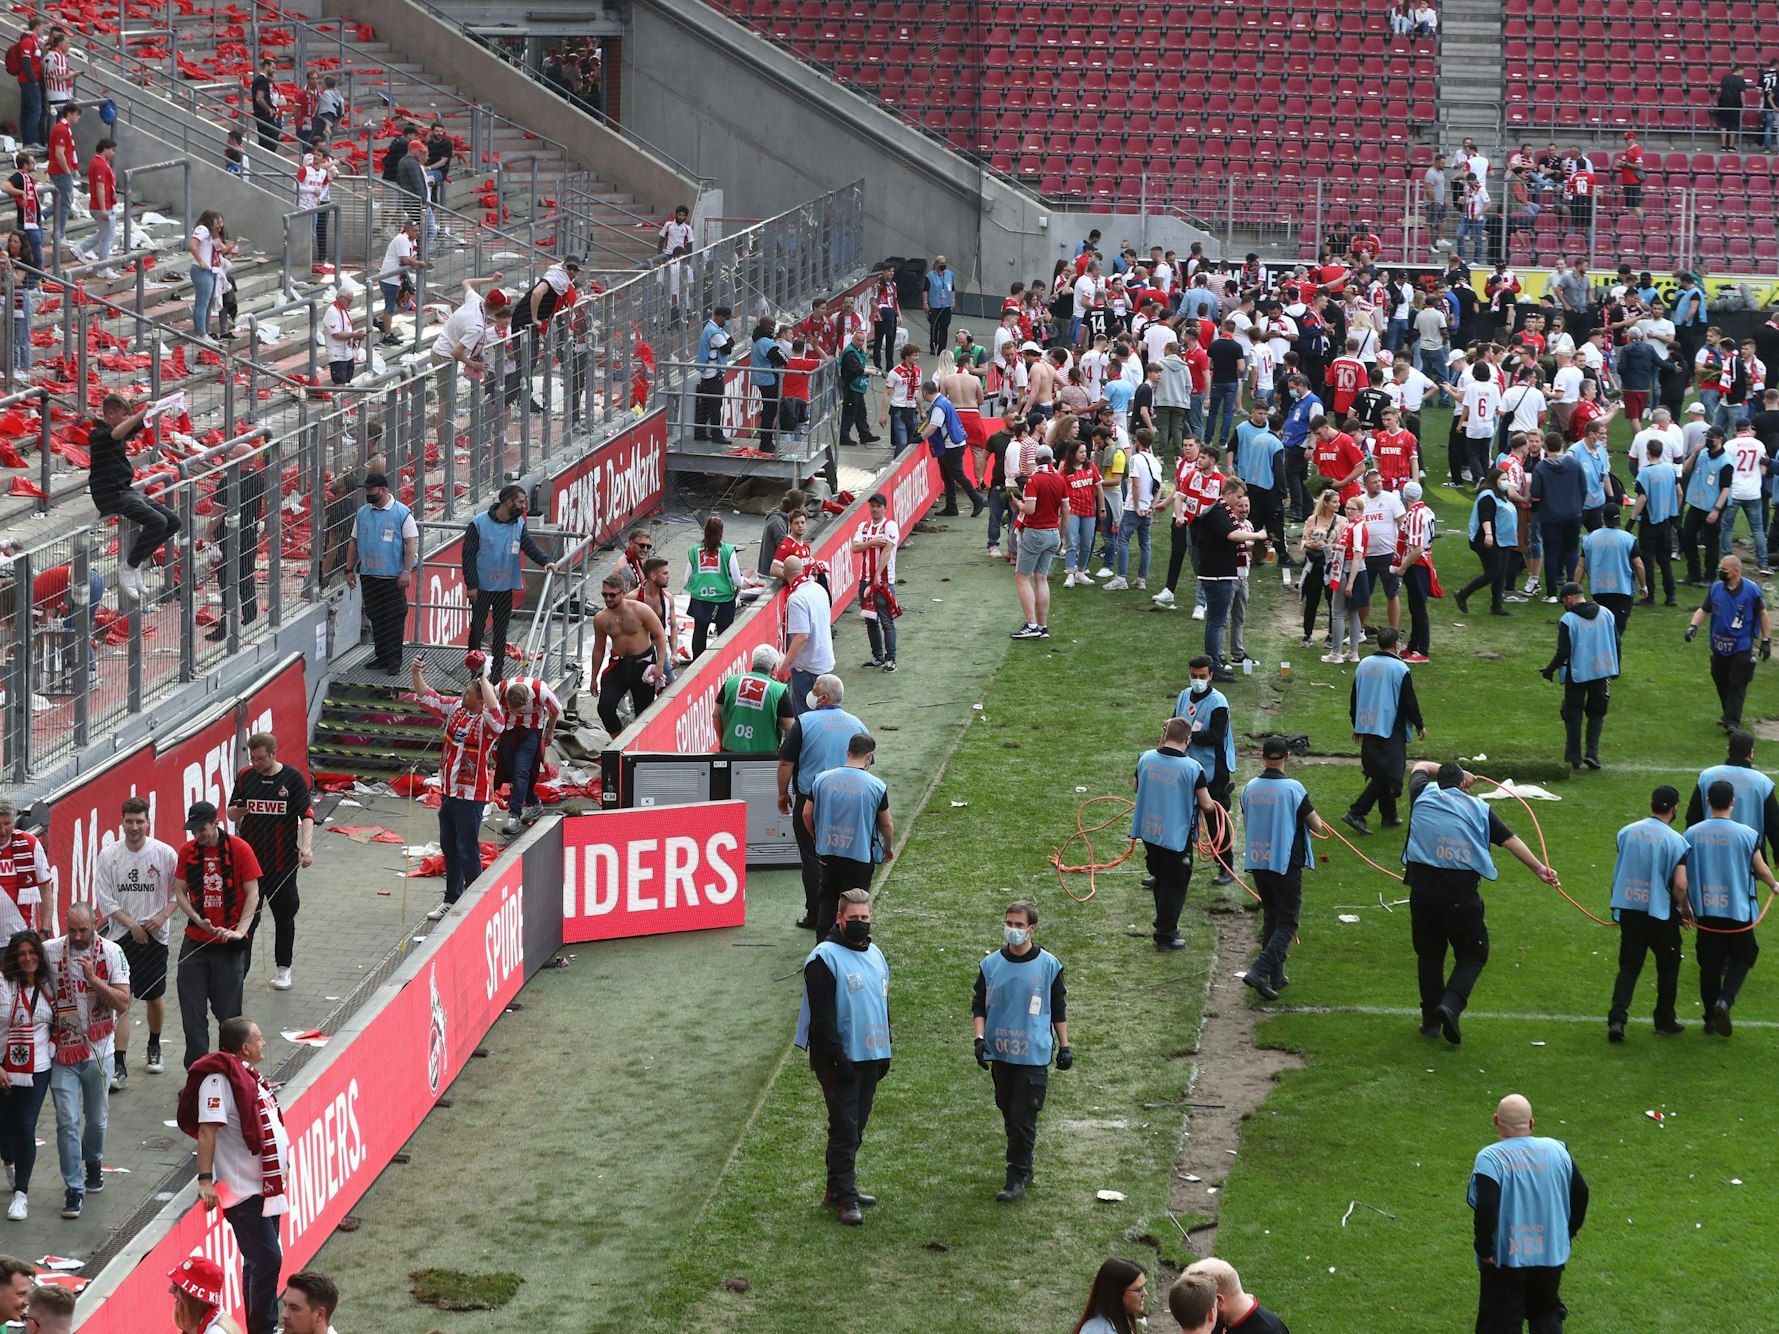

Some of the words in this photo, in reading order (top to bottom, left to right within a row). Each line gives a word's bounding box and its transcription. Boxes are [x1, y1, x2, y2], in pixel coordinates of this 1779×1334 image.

[1089, 316, 1107, 335] 14
[1336, 368, 1357, 389] 10
[1477, 397, 1488, 418] 6
[1319, 453, 1337, 461] REWE
[1380, 447, 1402, 455] REWE
[1736, 449, 1758, 472] 27
[629, 434, 661, 509] Markt
[1070, 478, 1094, 489] REWE
[1365, 512, 1384, 522] EWE
[700, 586, 717, 597] 05
[429, 567, 464, 646] Dein
[734, 723, 754, 739] 08
[249, 801, 286, 814] REWE
[116, 883, 156, 894] SAMSUNG
